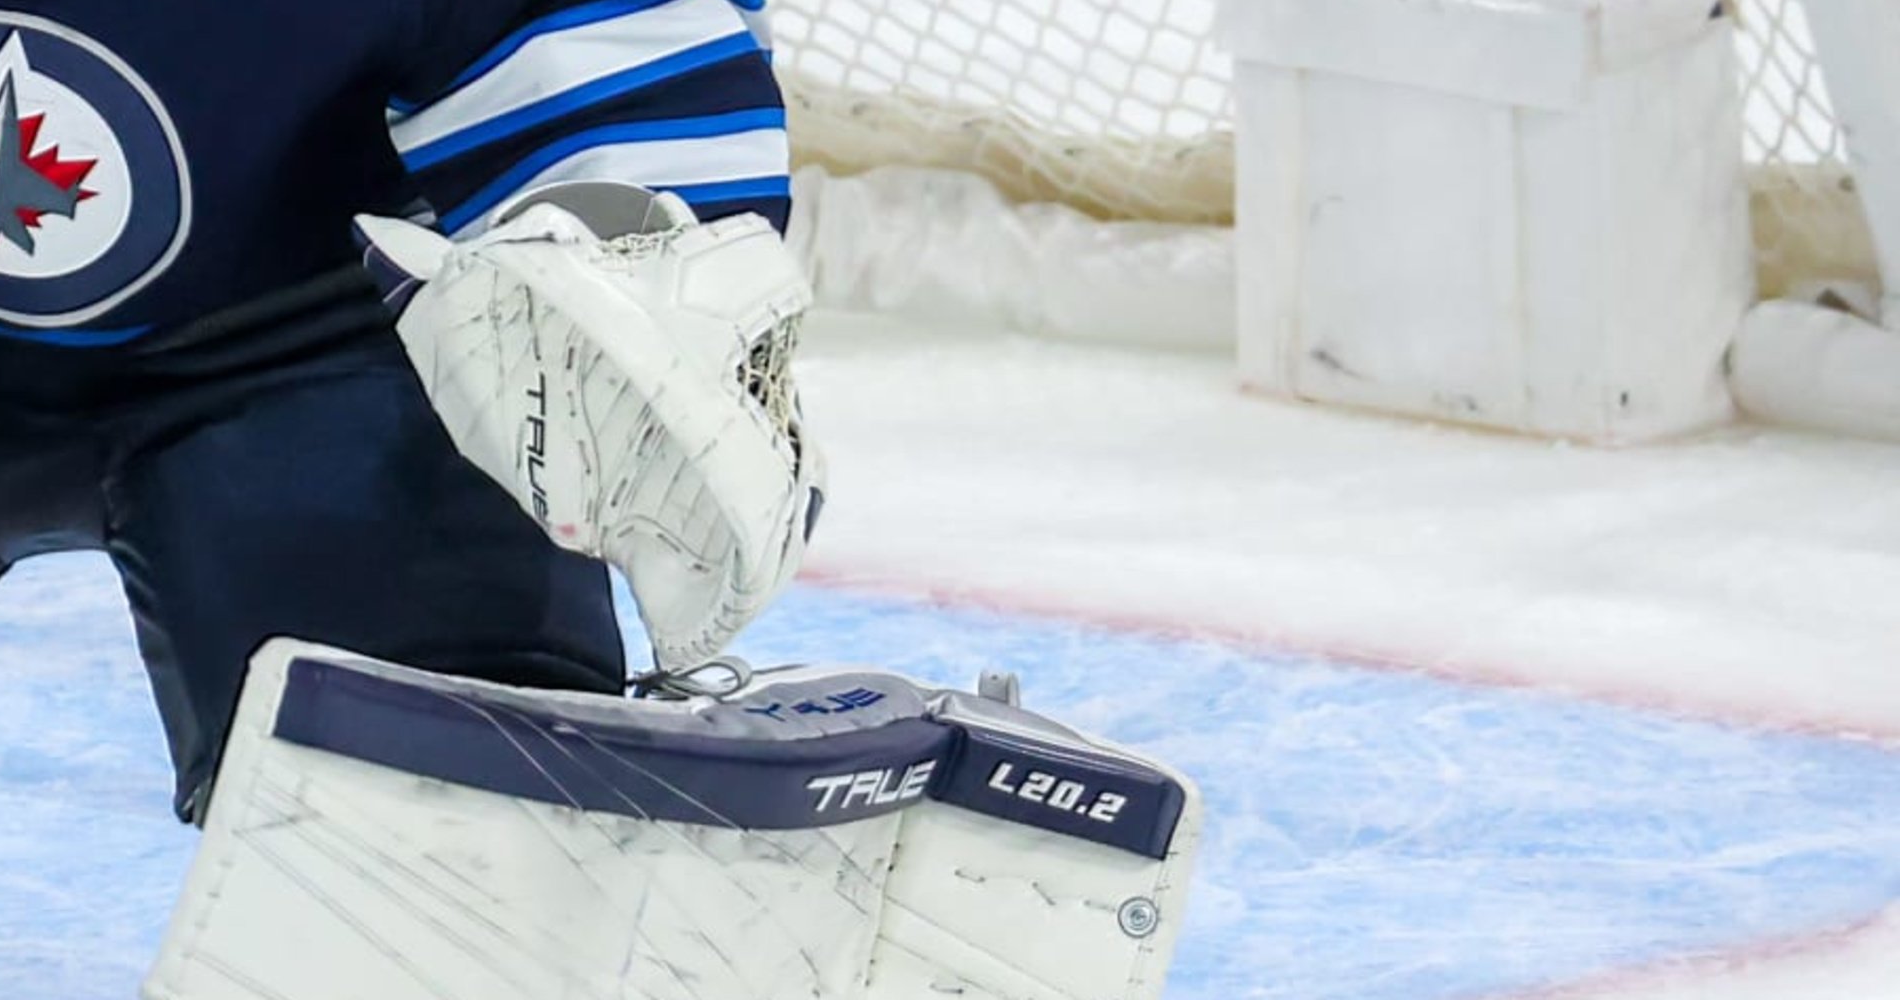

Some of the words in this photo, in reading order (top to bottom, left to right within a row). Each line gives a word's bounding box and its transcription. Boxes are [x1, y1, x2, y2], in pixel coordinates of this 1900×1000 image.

[527, 373, 550, 524] TRUE
[806, 759, 938, 812] TRUE
[987, 761, 1126, 822] L20.2
